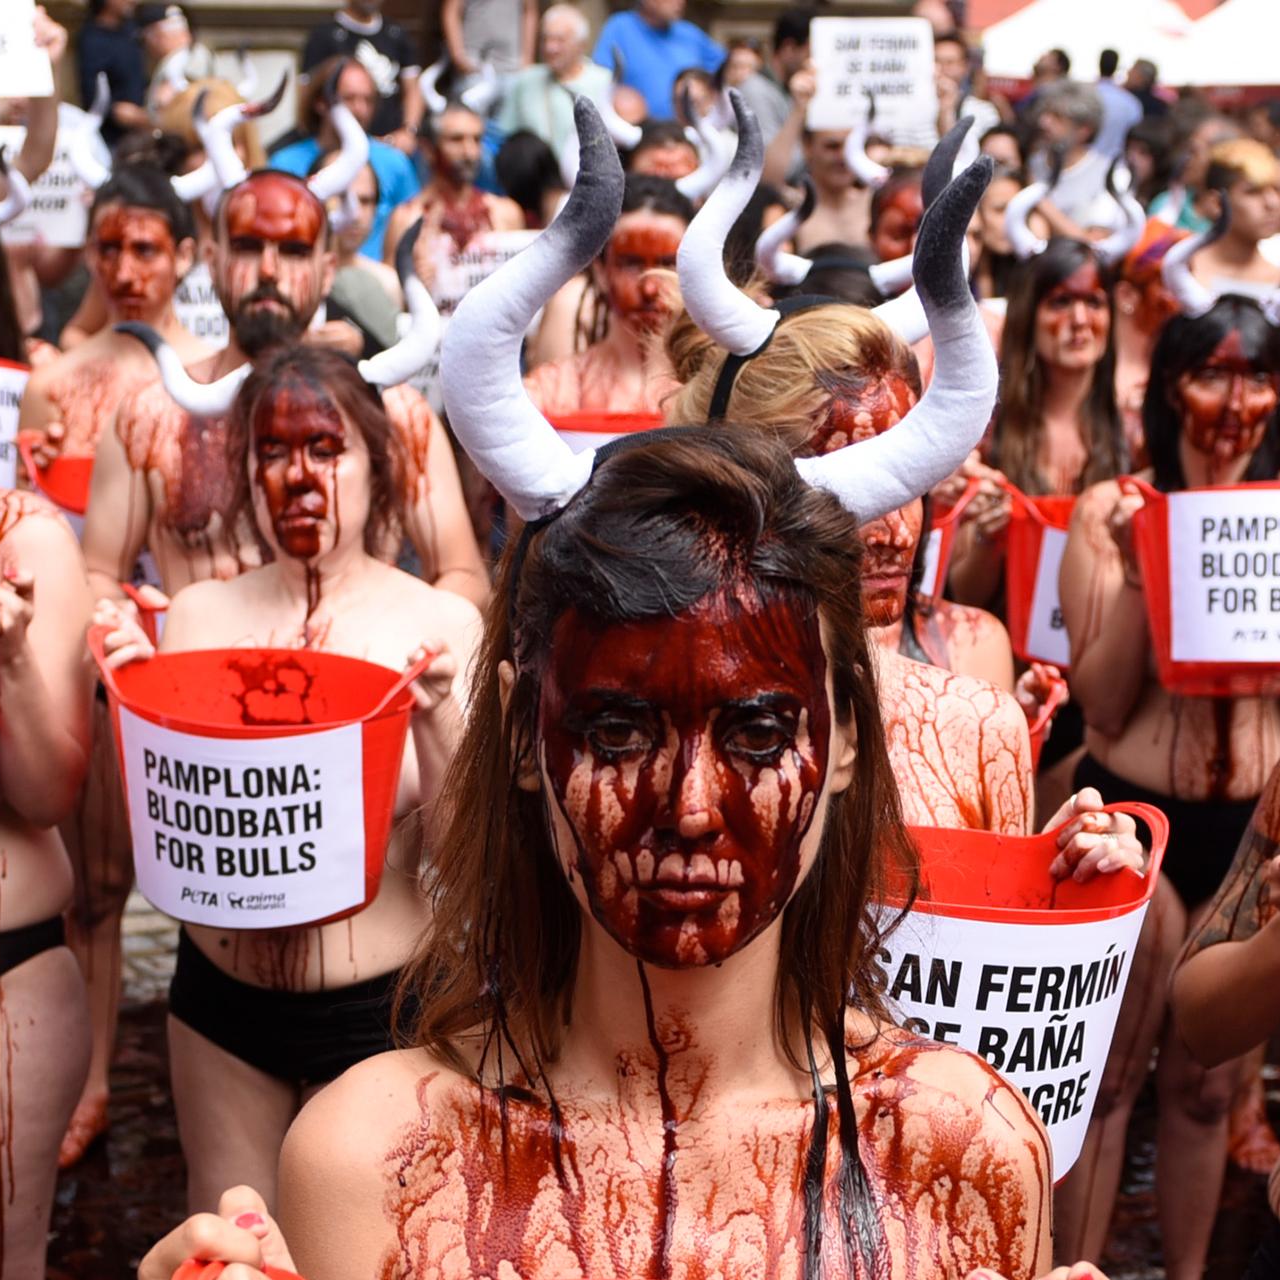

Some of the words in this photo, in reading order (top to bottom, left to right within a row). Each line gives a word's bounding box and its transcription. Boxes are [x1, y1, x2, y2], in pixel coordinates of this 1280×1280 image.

[1207, 588, 1258, 613] FOR
[143, 748, 321, 799] PAMPLONA:
[146, 788, 323, 839] BLOODBATH
[154, 830, 206, 874] FOR
[215, 841, 317, 878] BULLS
[975, 943, 1127, 1013] FERMÍN
[977, 1012, 1086, 1073] BAÑA
